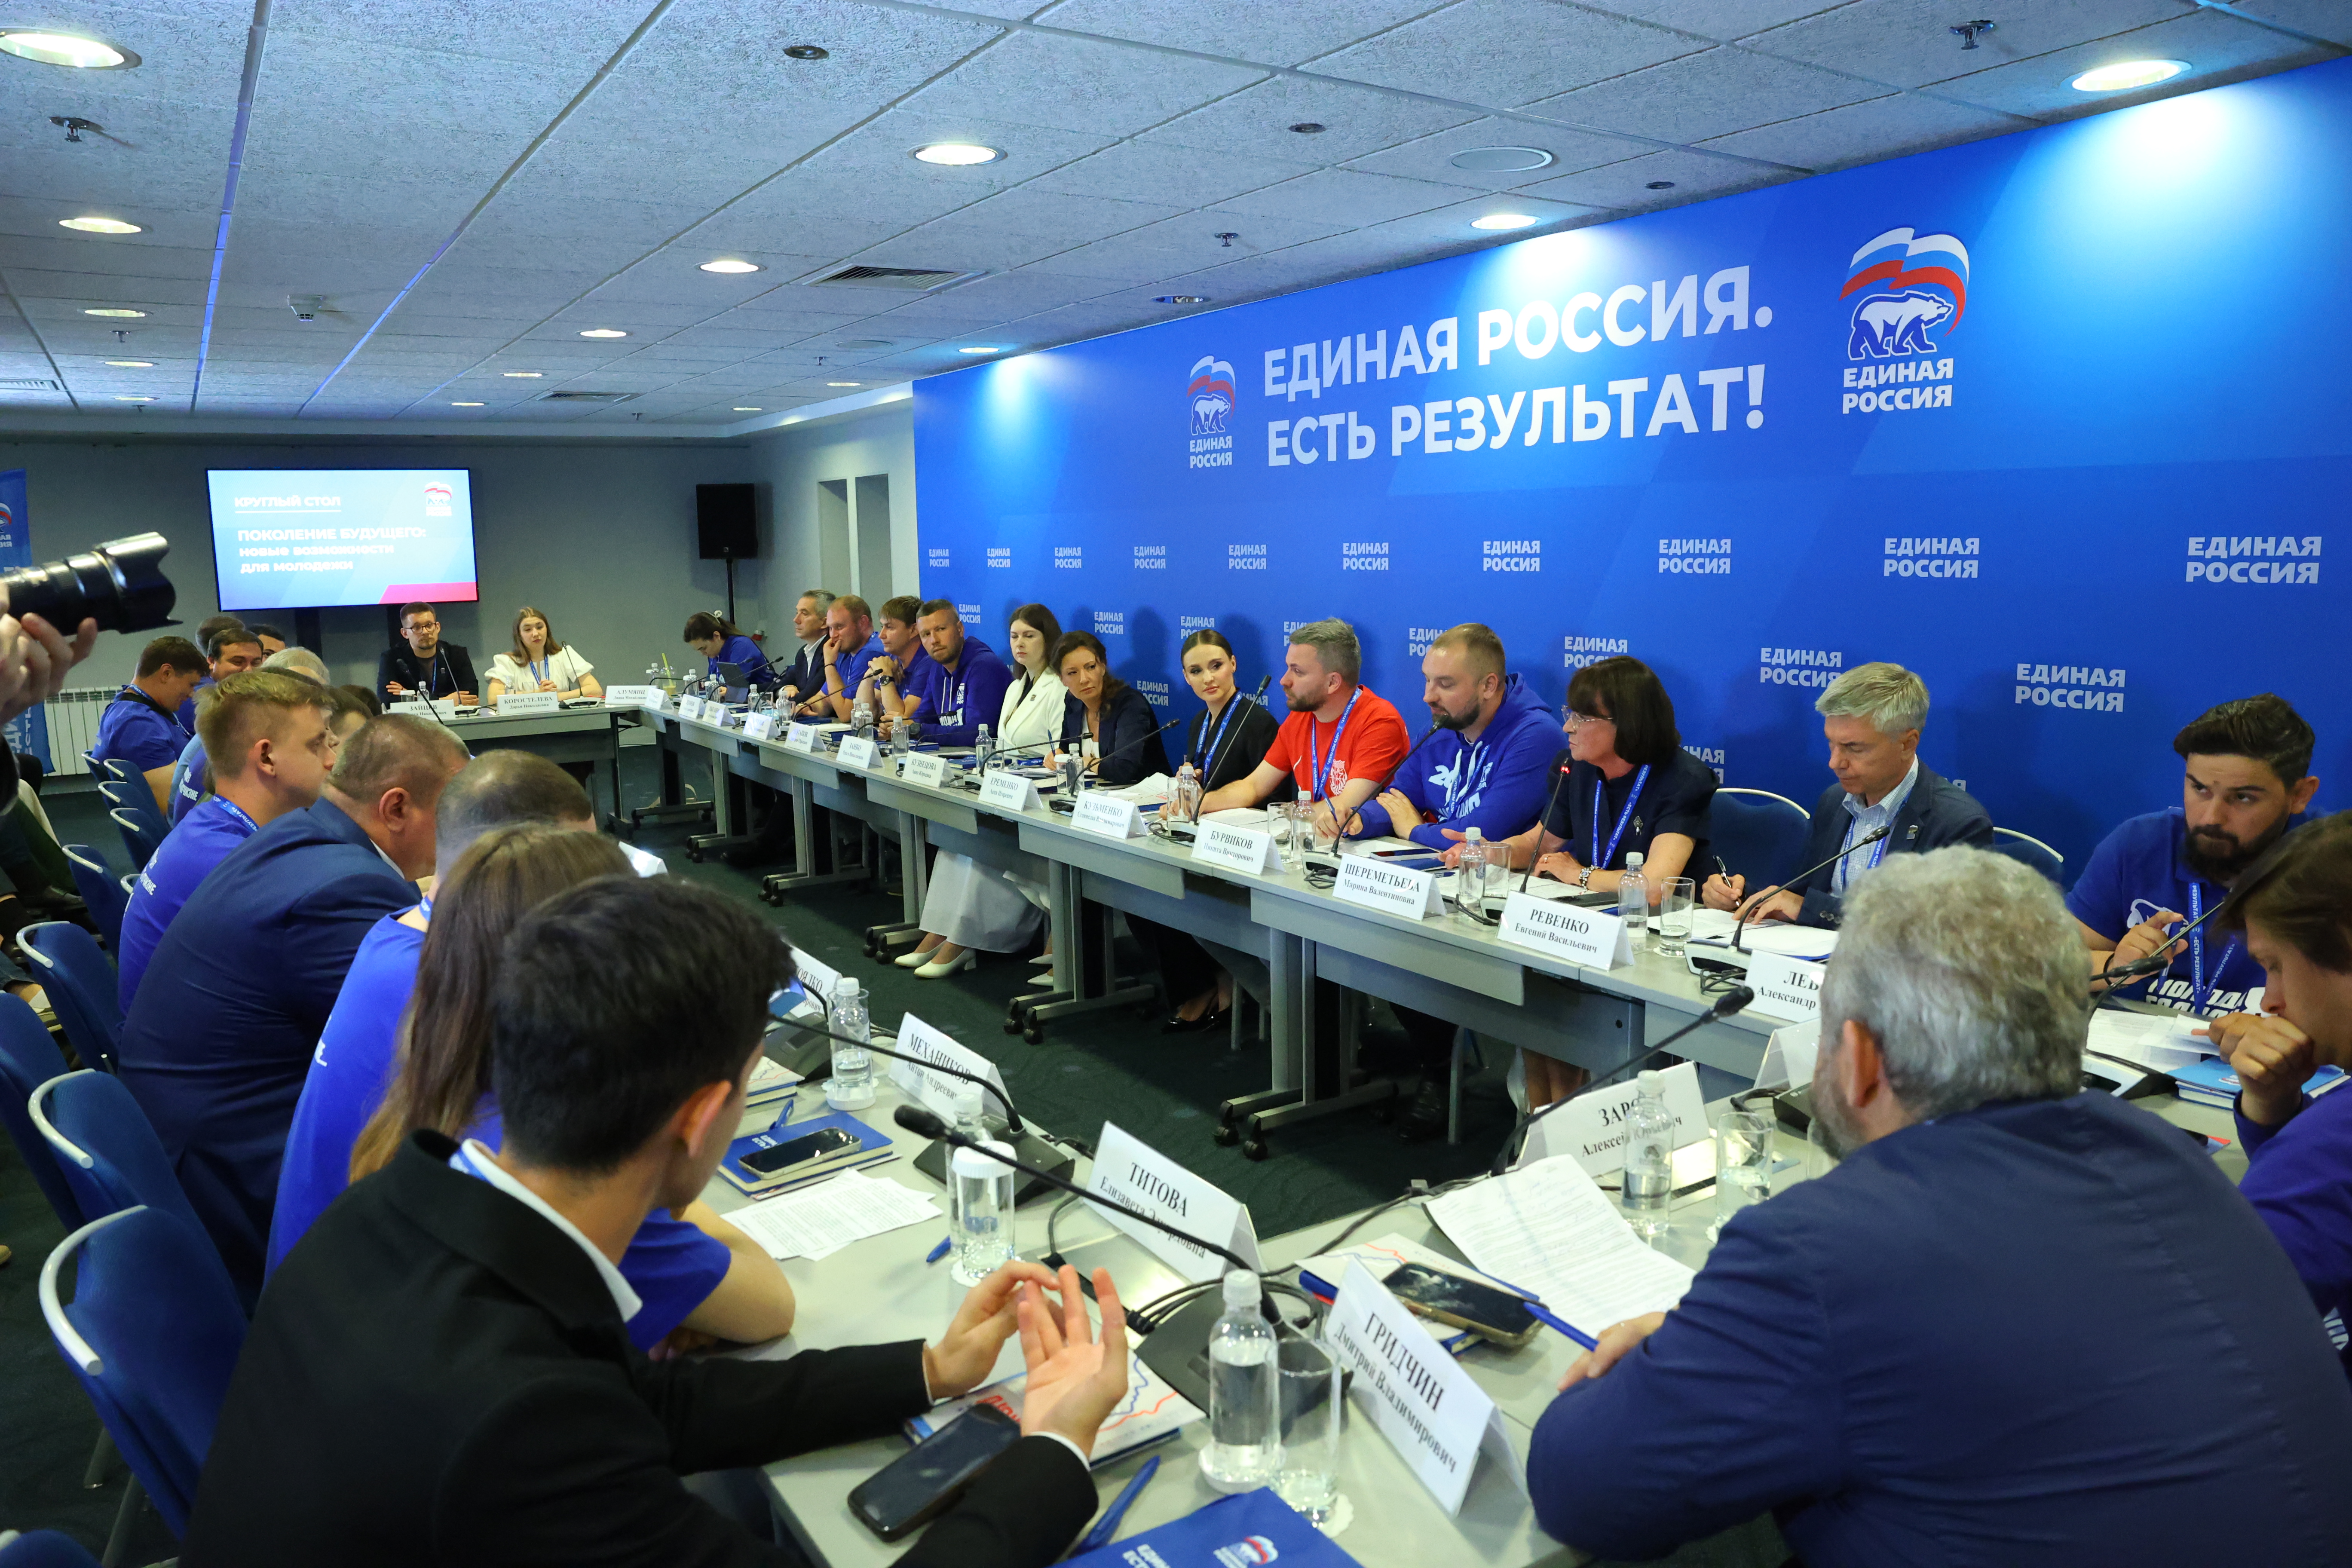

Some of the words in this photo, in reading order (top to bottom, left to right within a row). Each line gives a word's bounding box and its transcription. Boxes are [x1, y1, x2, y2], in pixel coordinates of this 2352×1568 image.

[1265, 317, 1458, 402] ЕДИНАЯ
[1478, 265, 1773, 366] РОССИЯ.
[1843, 358, 1954, 389] ЕДИНАЯ
[1842, 384, 1953, 415] РОССИЯ
[1268, 411, 1376, 466] ЕСТЬ
[1391, 364, 1766, 456] РЕЗУЛЬТАТ!
[1190, 435, 1232, 453] ЕДИНАЯ
[1190, 451, 1232, 469] РОССИЯ
[234, 495, 301, 507] КРУГЛЫЙ
[303, 496, 341, 507] СТОЛ
[238, 529, 337, 541] ПОКОЛЕНИЕ
[340, 527, 426, 540] БУДУЩЕГО:
[239, 547, 289, 557] новые
[293, 545, 394, 556] возможности
[929, 548, 949, 557] ЕДИНАЯ
[987, 548, 1011, 557] ЕДИНАЯ
[1054, 547, 1081, 557] ЕДИНАЯ
[1134, 546, 1166, 557] ЕДИНАЯ
[1228, 544, 1267, 556] ЕДИНАЯ
[1343, 542, 1389, 556] ЕДИНАЯ
[1483, 540, 1540, 554] ЕДИНАЯ
[1659, 539, 1731, 554] ЕДИНАЯ
[1884, 538, 1980, 557] ЕДИНАЯ
[2188, 536, 2322, 559] ЕДИНАЯ
[240, 562, 270, 574] для
[273, 560, 353, 572] молодежи
[929, 558, 949, 567] РОССИЯ
[987, 558, 1011, 568] РОССИЯ
[1055, 558, 1082, 568] РОССИЯ
[1134, 558, 1166, 569] РОССИЯ
[1229, 558, 1267, 570] РОССИЯ
[1343, 557, 1389, 570] РОССИЯ
[1483, 557, 1540, 572] РОССИЯ
[1658, 557, 1730, 574] РОССИЯ
[1883, 559, 1978, 579] РОССИЯ
[2186, 562, 2319, 584] РОССИЯ
[959, 604, 980, 613] ЕДИНАЯ
[1094, 611, 1123, 622] ЕДИНАЯ
[1180, 616, 1215, 628] ЕДИНАЯ
[1094, 623, 1124, 635] РОССИЯ
[1565, 636, 1628, 653] ЕДИНАЯ
[1761, 647, 1842, 668] ЕДИНАЯ
[2016, 663, 2126, 688] ЕДИНАЯ
[1137, 680, 1168, 693] ЕДИНАЯ
[1142, 693, 1169, 706] ОССИЯ
[2015, 685, 2125, 713] РОССИЯ
[911, 758, 936, 771] КУЗНЕЦОВА
[990, 777, 1018, 790] ЕРЕМЕНКО
[998, 790, 1013, 799] Игоревна
[1078, 811, 1096, 821] Станислав
[1084, 800, 1123, 817] КУЗЬМЕНКО
[1210, 830, 1253, 850] БУРВИКОВ
[1204, 842, 1222, 854] Никита
[1222, 847, 1254, 863] Викторович
[1344, 863, 1420, 892] ШЕРЕМЕТЬЕВА
[1343, 878, 1368, 893] Марина
[1369, 886, 1415, 905] Валентиновна
[1529, 908, 1589, 935] РЕВЕНКО
[1515, 922, 1547, 939] Евгений
[1548, 932, 1598, 953] Васильевич
[1757, 986, 1817, 1011] Александр
[907, 1033, 971, 1085] МЕХАНИКОВ
[906, 1061, 925, 1078] Антон
[925, 1072, 957, 1100] Андрееви
[1127, 1162, 1188, 1218] ТИТОВА
[1363, 1312, 1445, 1413] ГРИДЧИН
[1333, 1322, 1375, 1380] Дмитрий
[1375, 1370, 1457, 1474] Владимирович
